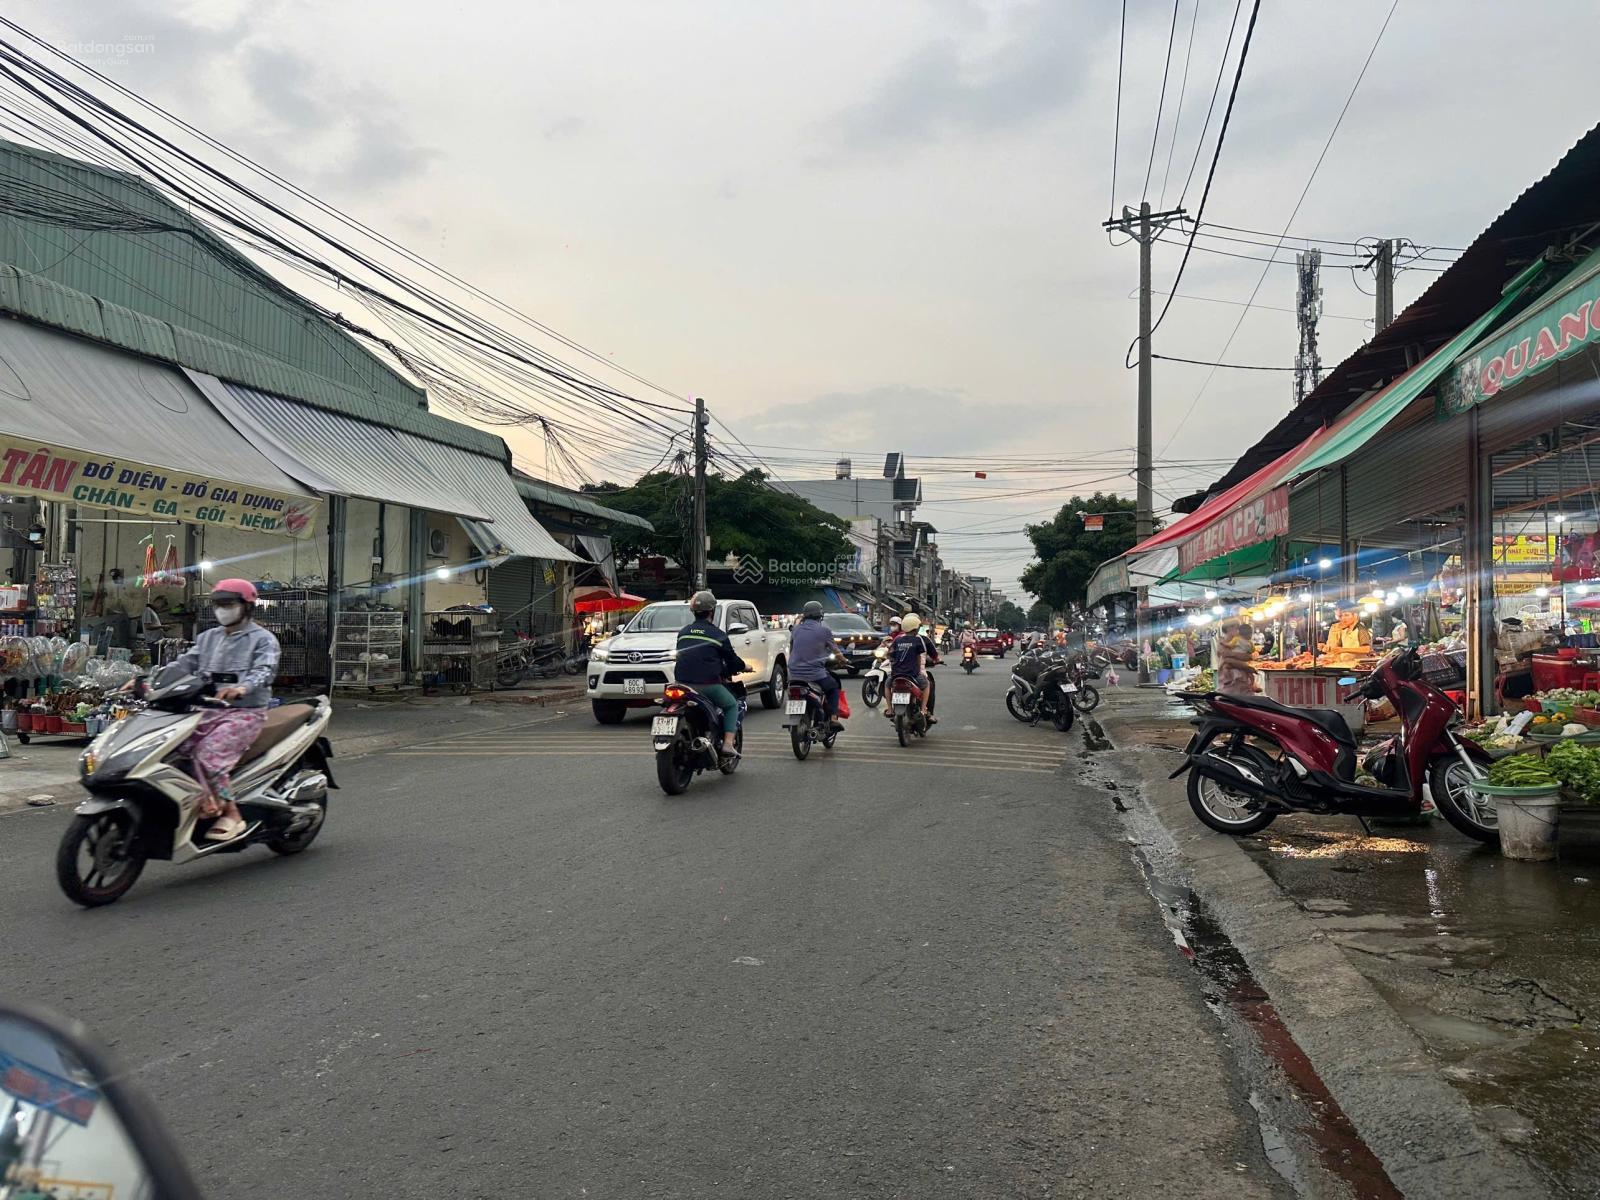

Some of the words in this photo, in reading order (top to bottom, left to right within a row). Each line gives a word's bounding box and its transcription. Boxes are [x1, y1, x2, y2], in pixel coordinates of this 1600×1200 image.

[0, 448, 79, 493] TÂN
[82, 461, 116, 481] ĐỒ
[117, 469, 167, 491] ĐIỆN
[181, 480, 209, 498] ĐỒ
[210, 487, 238, 504] GIA
[241, 493, 284, 512] DỤNG
[72, 484, 135, 508] CHĂN
[152, 499, 178, 516] GA
[195, 504, 226, 523] GỐI
